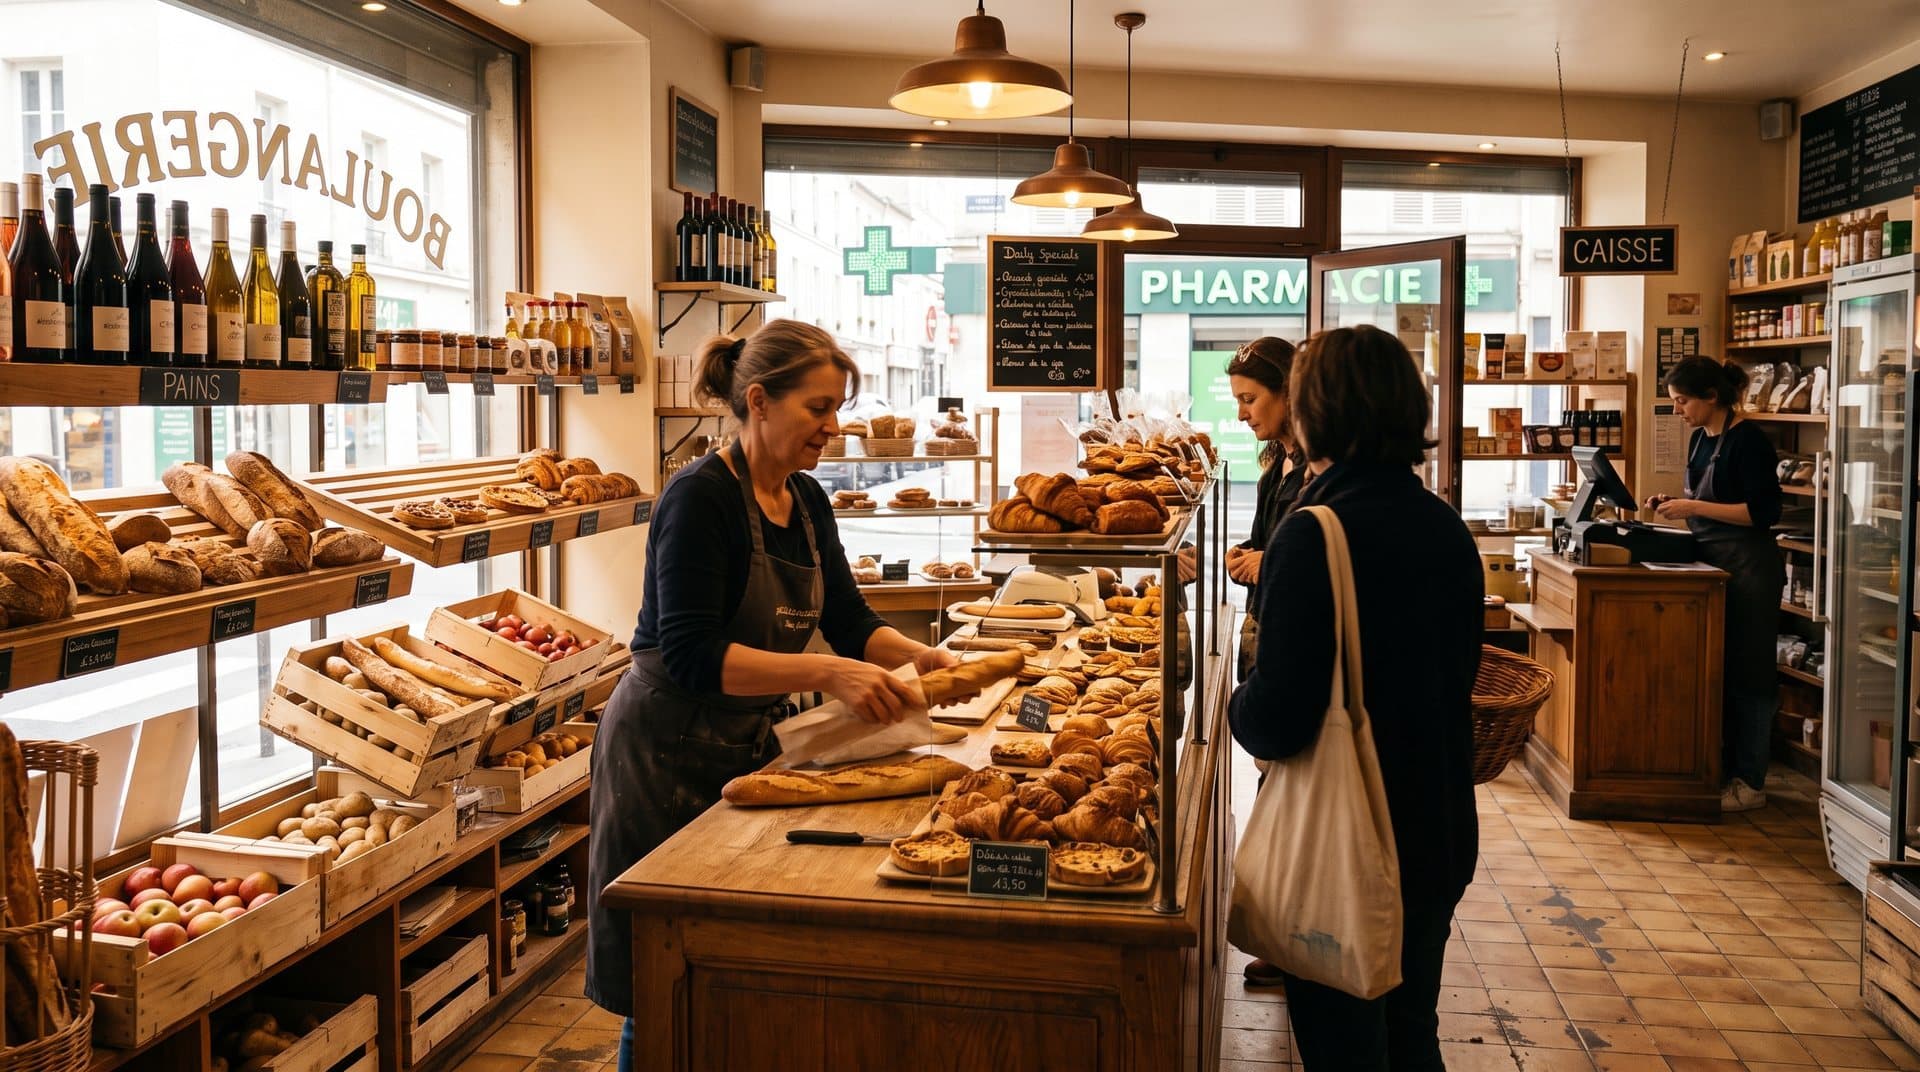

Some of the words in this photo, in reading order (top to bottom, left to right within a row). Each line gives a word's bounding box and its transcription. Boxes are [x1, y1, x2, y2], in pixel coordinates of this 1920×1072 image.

[1003, 246, 1034, 263] Daily
[1039, 247, 1079, 263] Specials
[1573, 237, 1664, 264] CAISSE
[1141, 268, 1422, 304] PHARMACIE
[164, 371, 221, 401] PAINS
